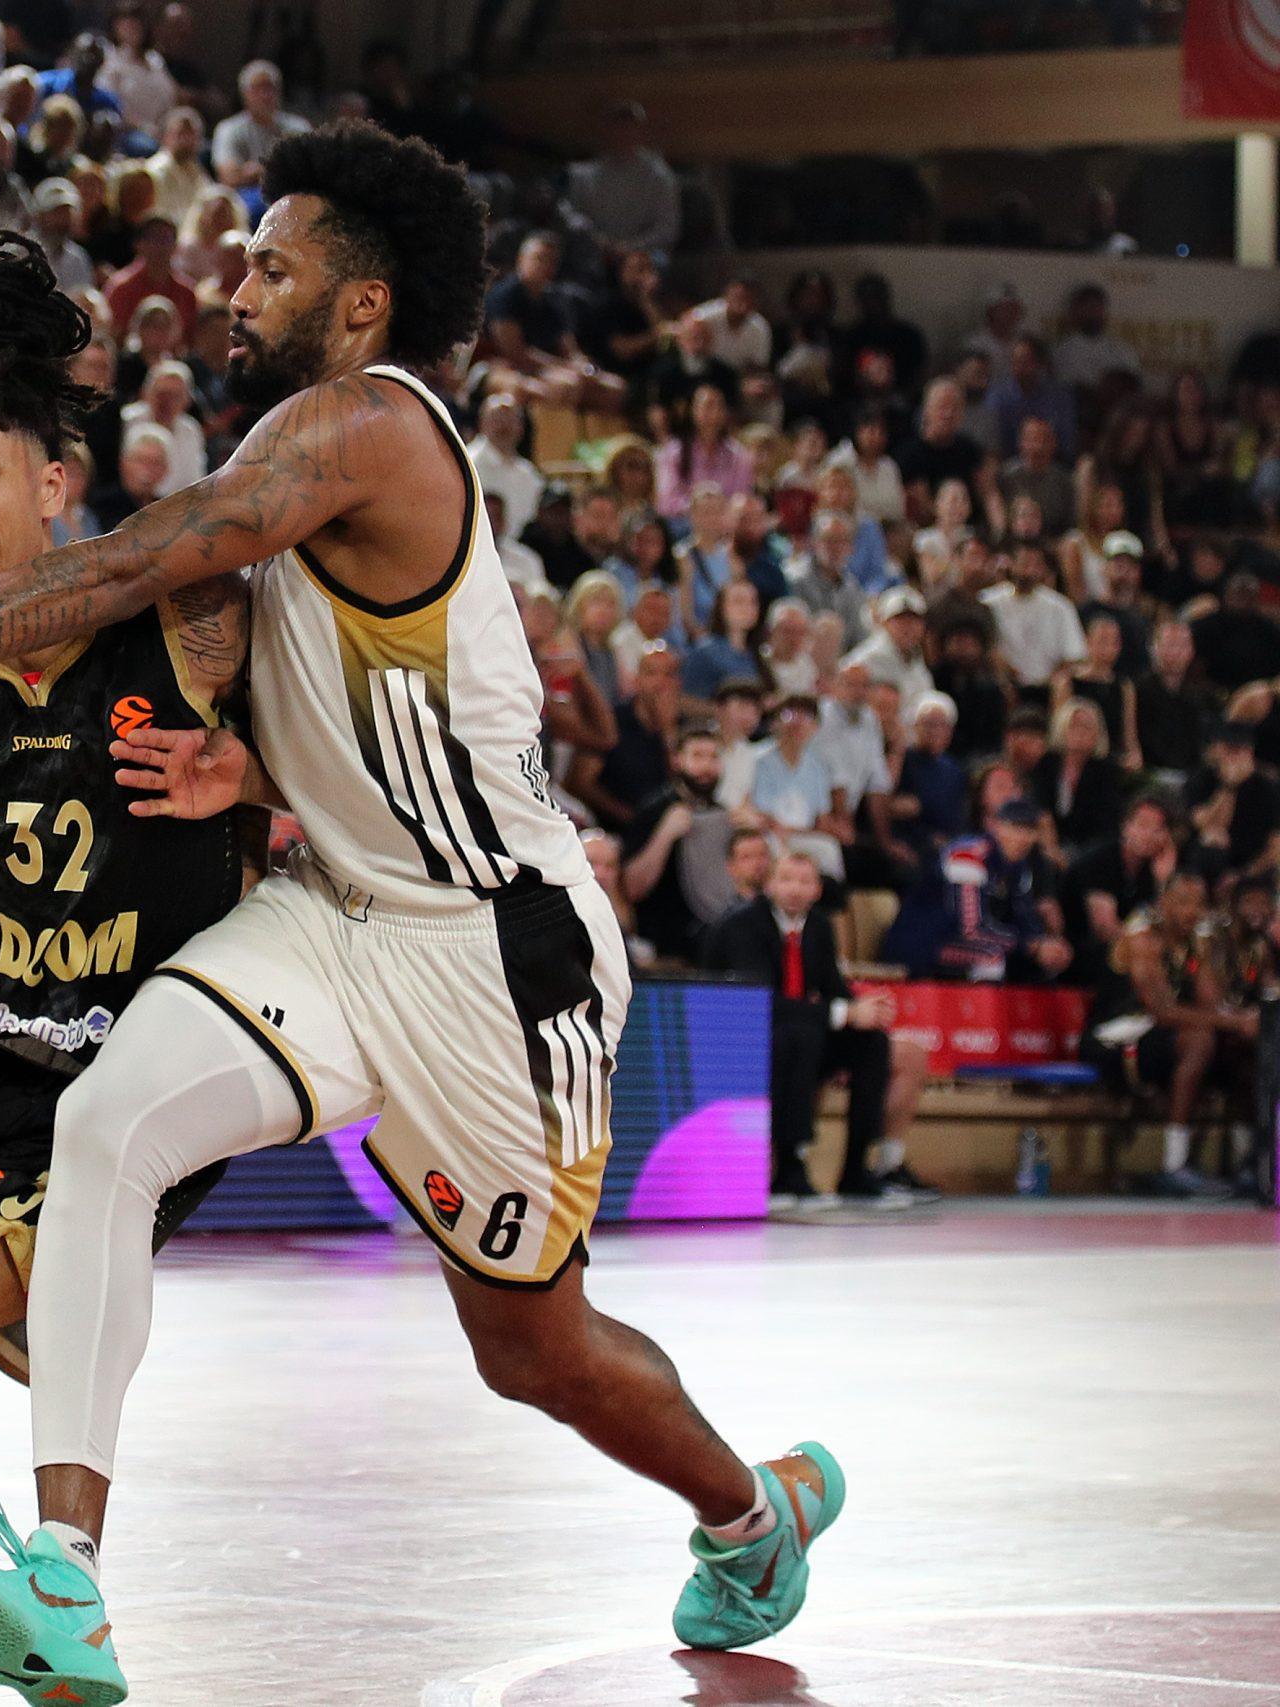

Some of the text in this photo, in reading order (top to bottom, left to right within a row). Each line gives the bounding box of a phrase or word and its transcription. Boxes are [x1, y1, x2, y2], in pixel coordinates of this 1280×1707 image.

[12, 734, 72, 752] SPALDING
[5, 799, 94, 892] 32
[479, 1192, 528, 1260] 6
